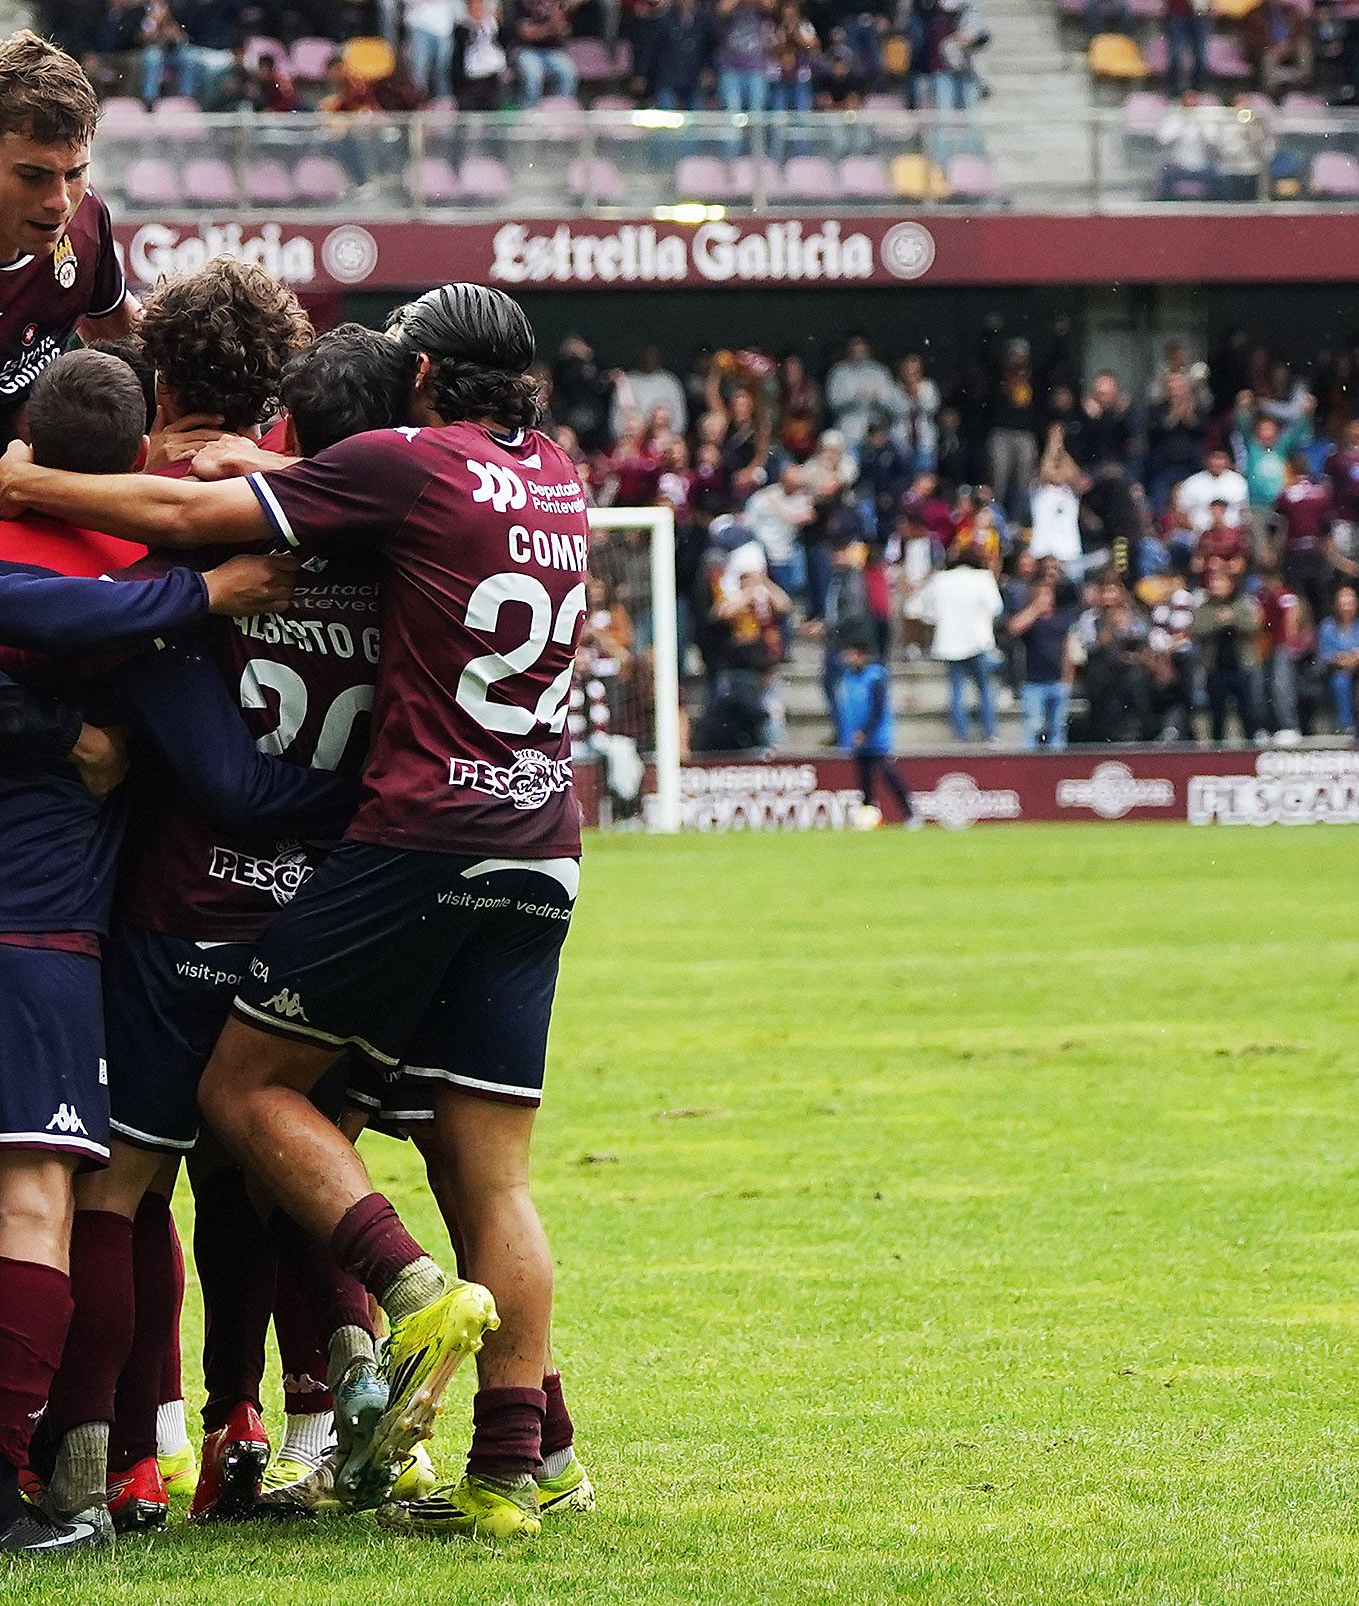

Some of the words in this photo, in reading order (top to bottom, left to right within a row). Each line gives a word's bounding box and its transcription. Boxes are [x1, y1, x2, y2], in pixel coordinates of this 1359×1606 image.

[490, 222, 688, 282] Estrella
[692, 219, 874, 282] Galicia
[508, 525, 588, 573] COMP
